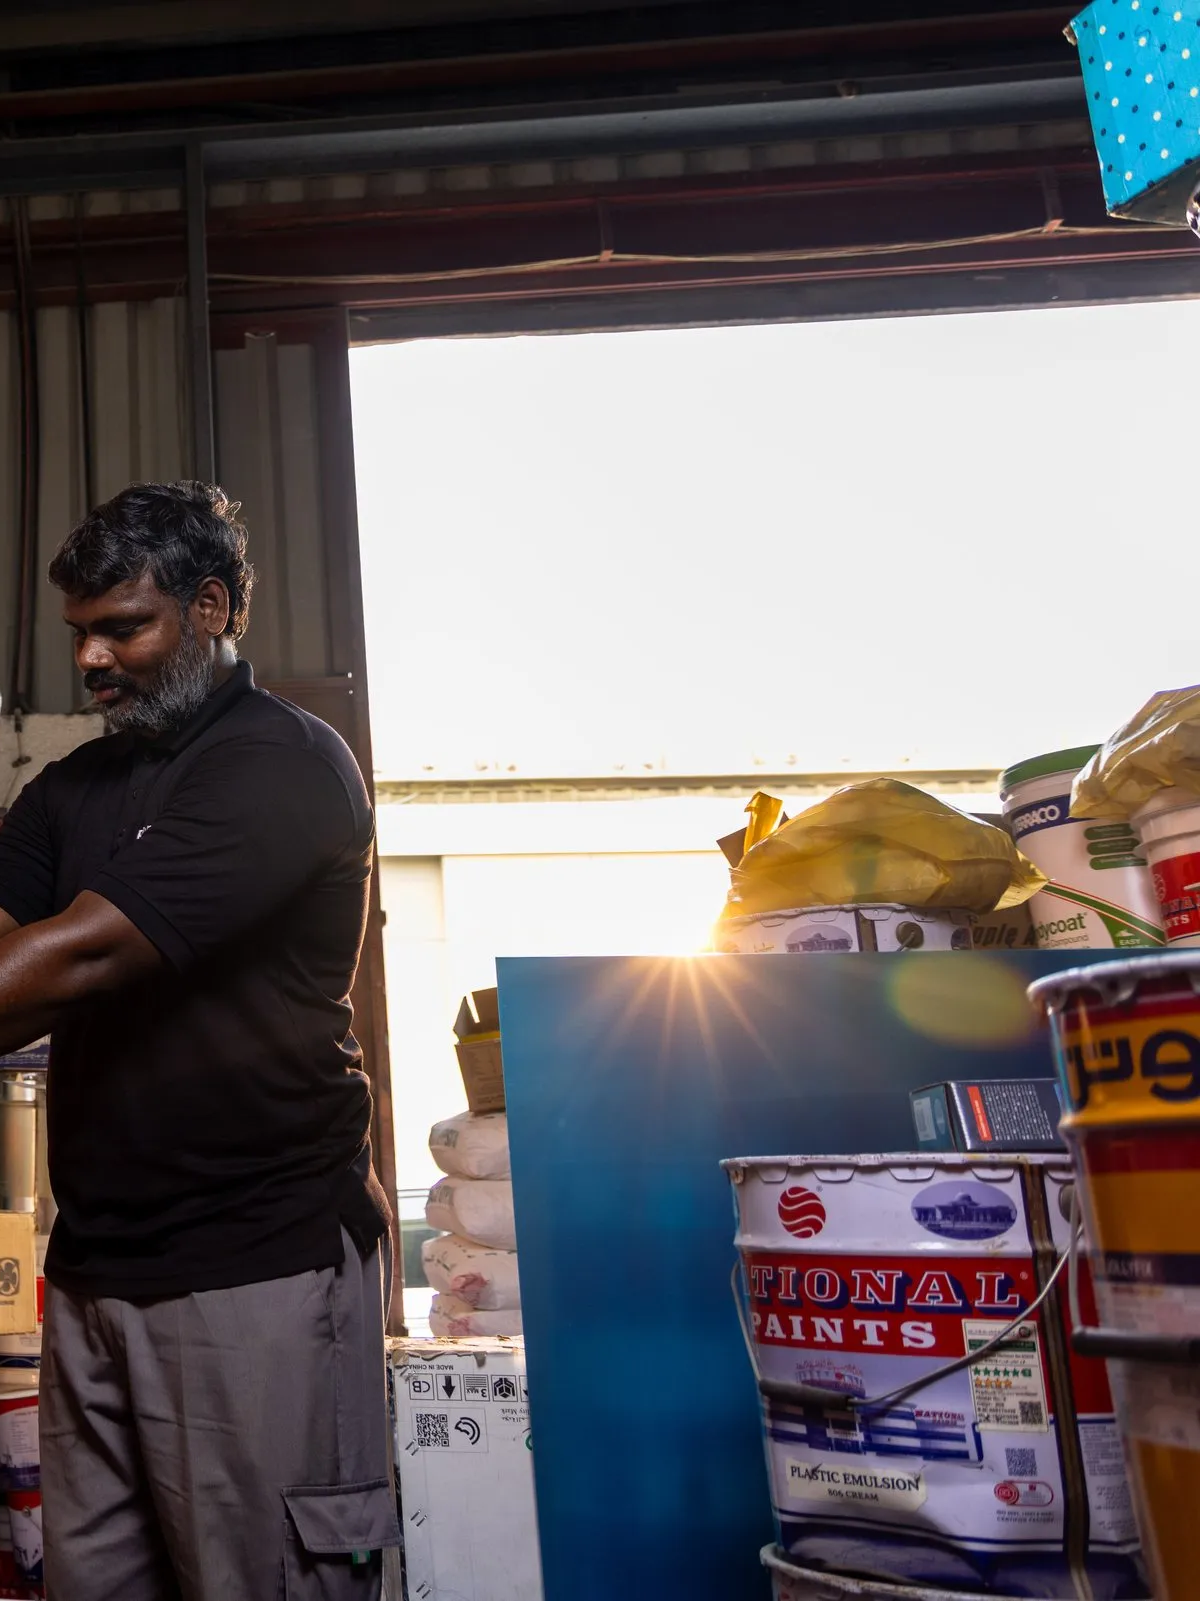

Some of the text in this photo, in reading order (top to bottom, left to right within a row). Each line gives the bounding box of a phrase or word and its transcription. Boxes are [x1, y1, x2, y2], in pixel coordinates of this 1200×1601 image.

[412, 1380, 431, 1393] CB
[790, 1465, 921, 1491] PLASTIC EMULSION
[845, 1491, 879, 1502] CREAM
